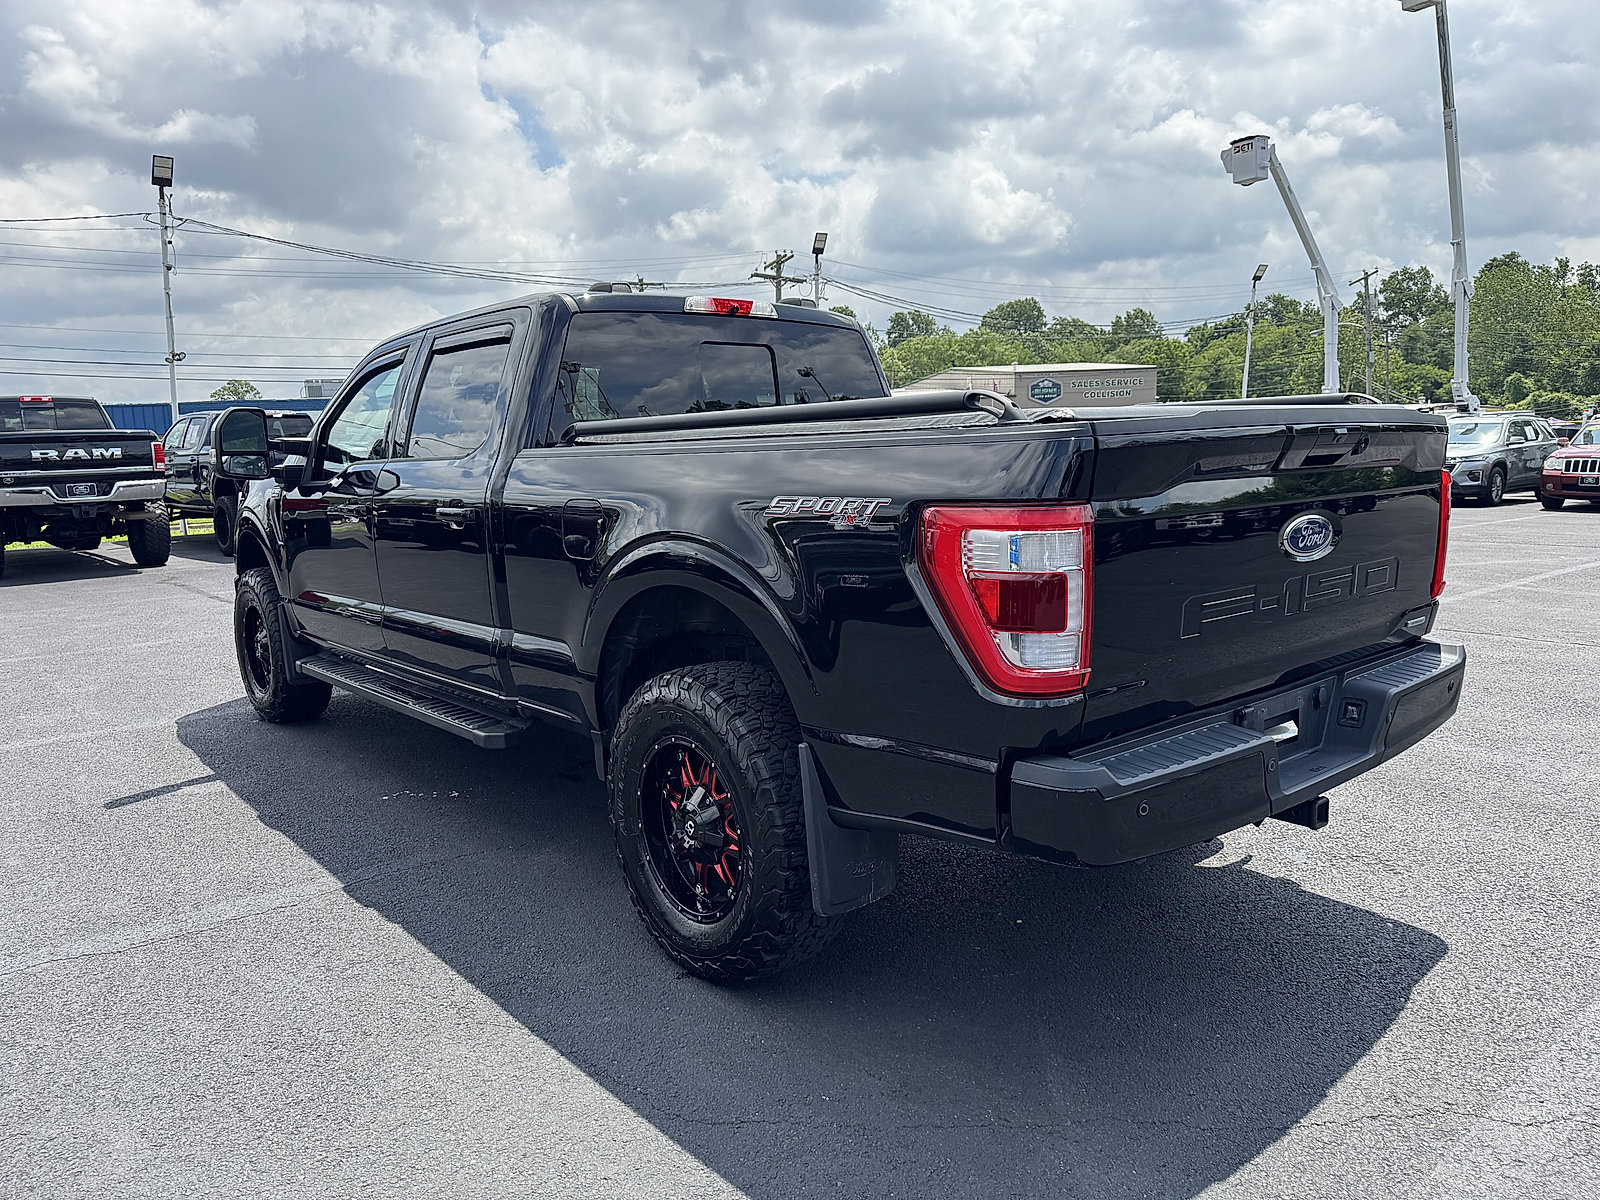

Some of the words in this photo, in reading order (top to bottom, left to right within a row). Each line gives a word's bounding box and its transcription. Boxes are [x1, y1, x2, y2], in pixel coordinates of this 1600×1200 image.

[1071, 380, 1100, 388] SALES
[1105, 377, 1144, 386] SERVICE
[1083, 390, 1131, 399] COLLISION
[30, 447, 122, 462] RAM
[763, 496, 892, 517] SPORT
[1298, 523, 1326, 548] Ford
[1180, 556, 1399, 639] F-150
